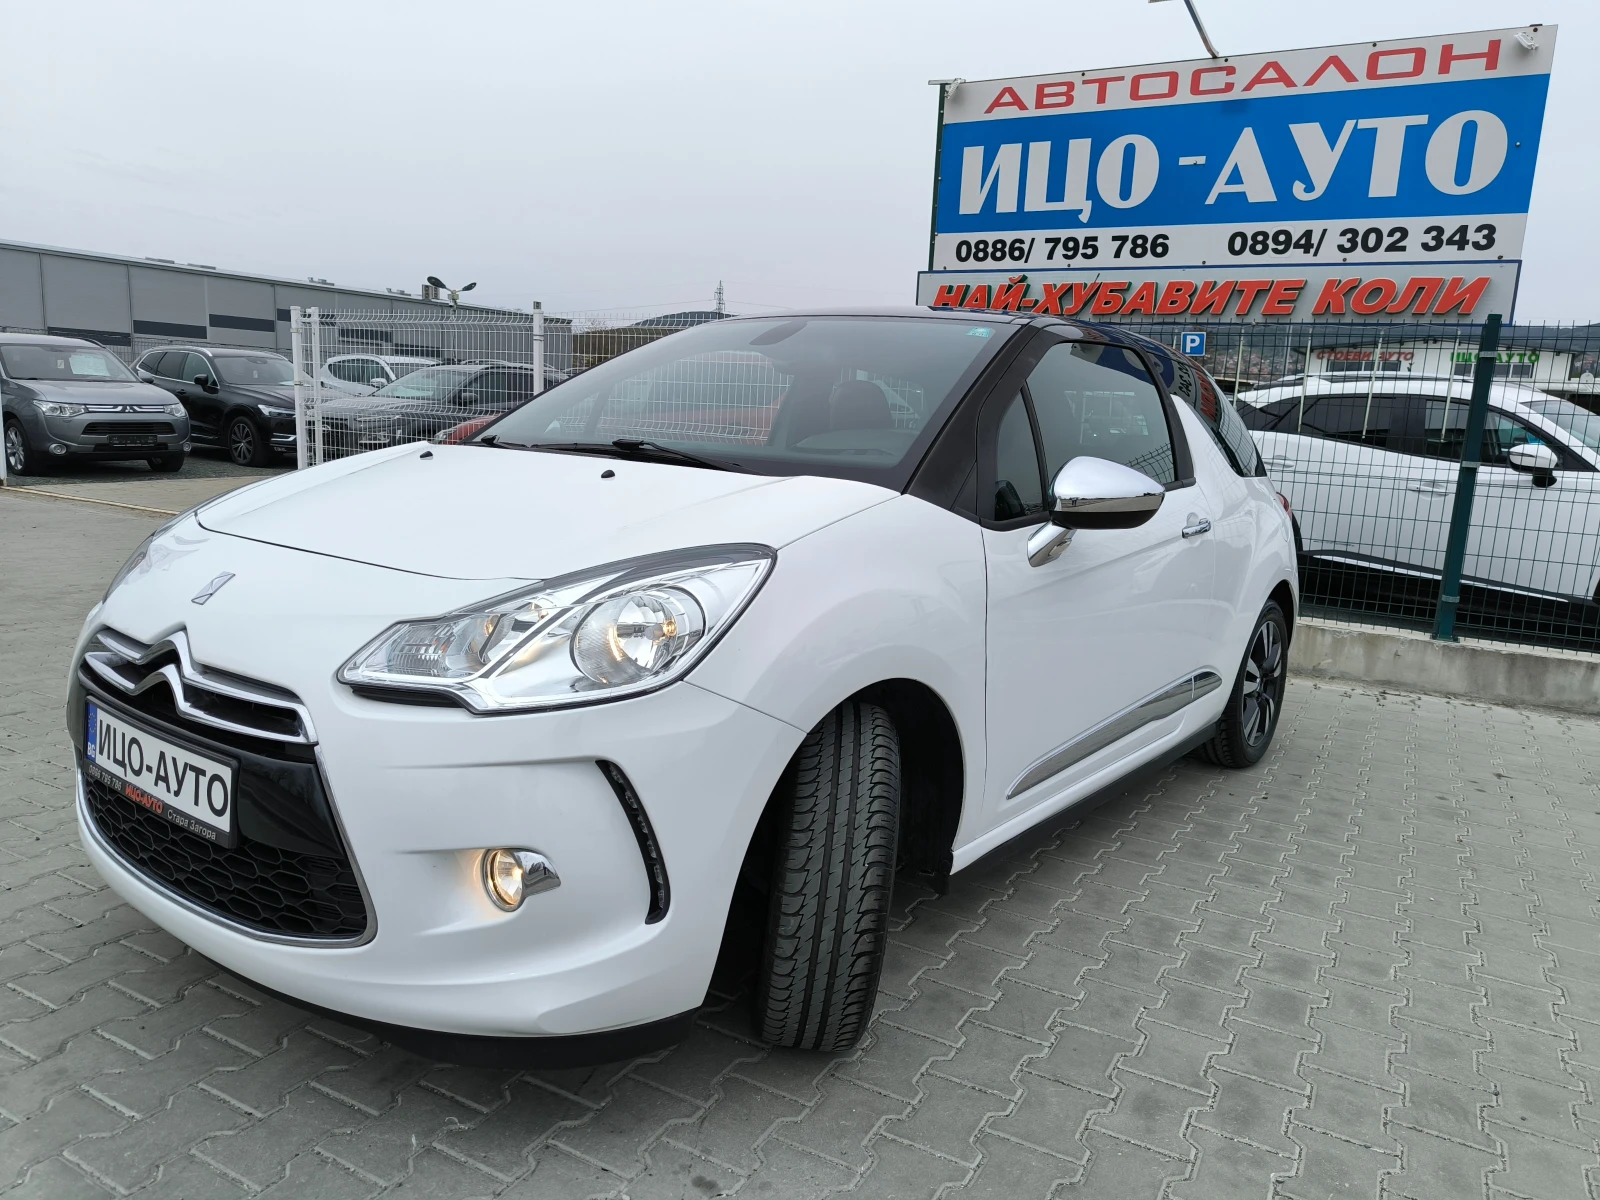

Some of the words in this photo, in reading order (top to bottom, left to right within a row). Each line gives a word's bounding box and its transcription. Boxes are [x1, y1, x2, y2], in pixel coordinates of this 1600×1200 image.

[984, 39, 1501, 114] АВТОСАЛОН
[955, 238, 1035, 263] 0886/
[1044, 236, 1099, 260] 795
[1111, 233, 1170, 258] 786
[1227, 228, 1328, 257] 0894/
[1337, 226, 1409, 253] 302
[1421, 223, 1497, 251] 343
[933, 274, 1307, 315] НАЙ-ХУБАВИТЕ
[1311, 276, 1491, 315] КОЛИ
[1185, 335, 1200, 353] P
[87, 741, 96, 758] BG
[98, 719, 229, 817] ИЦО-АУТО
[126, 783, 163, 814] ИЦО-АУТО
[167, 809, 189, 827] Стара
[190, 820, 216, 840] Загора
